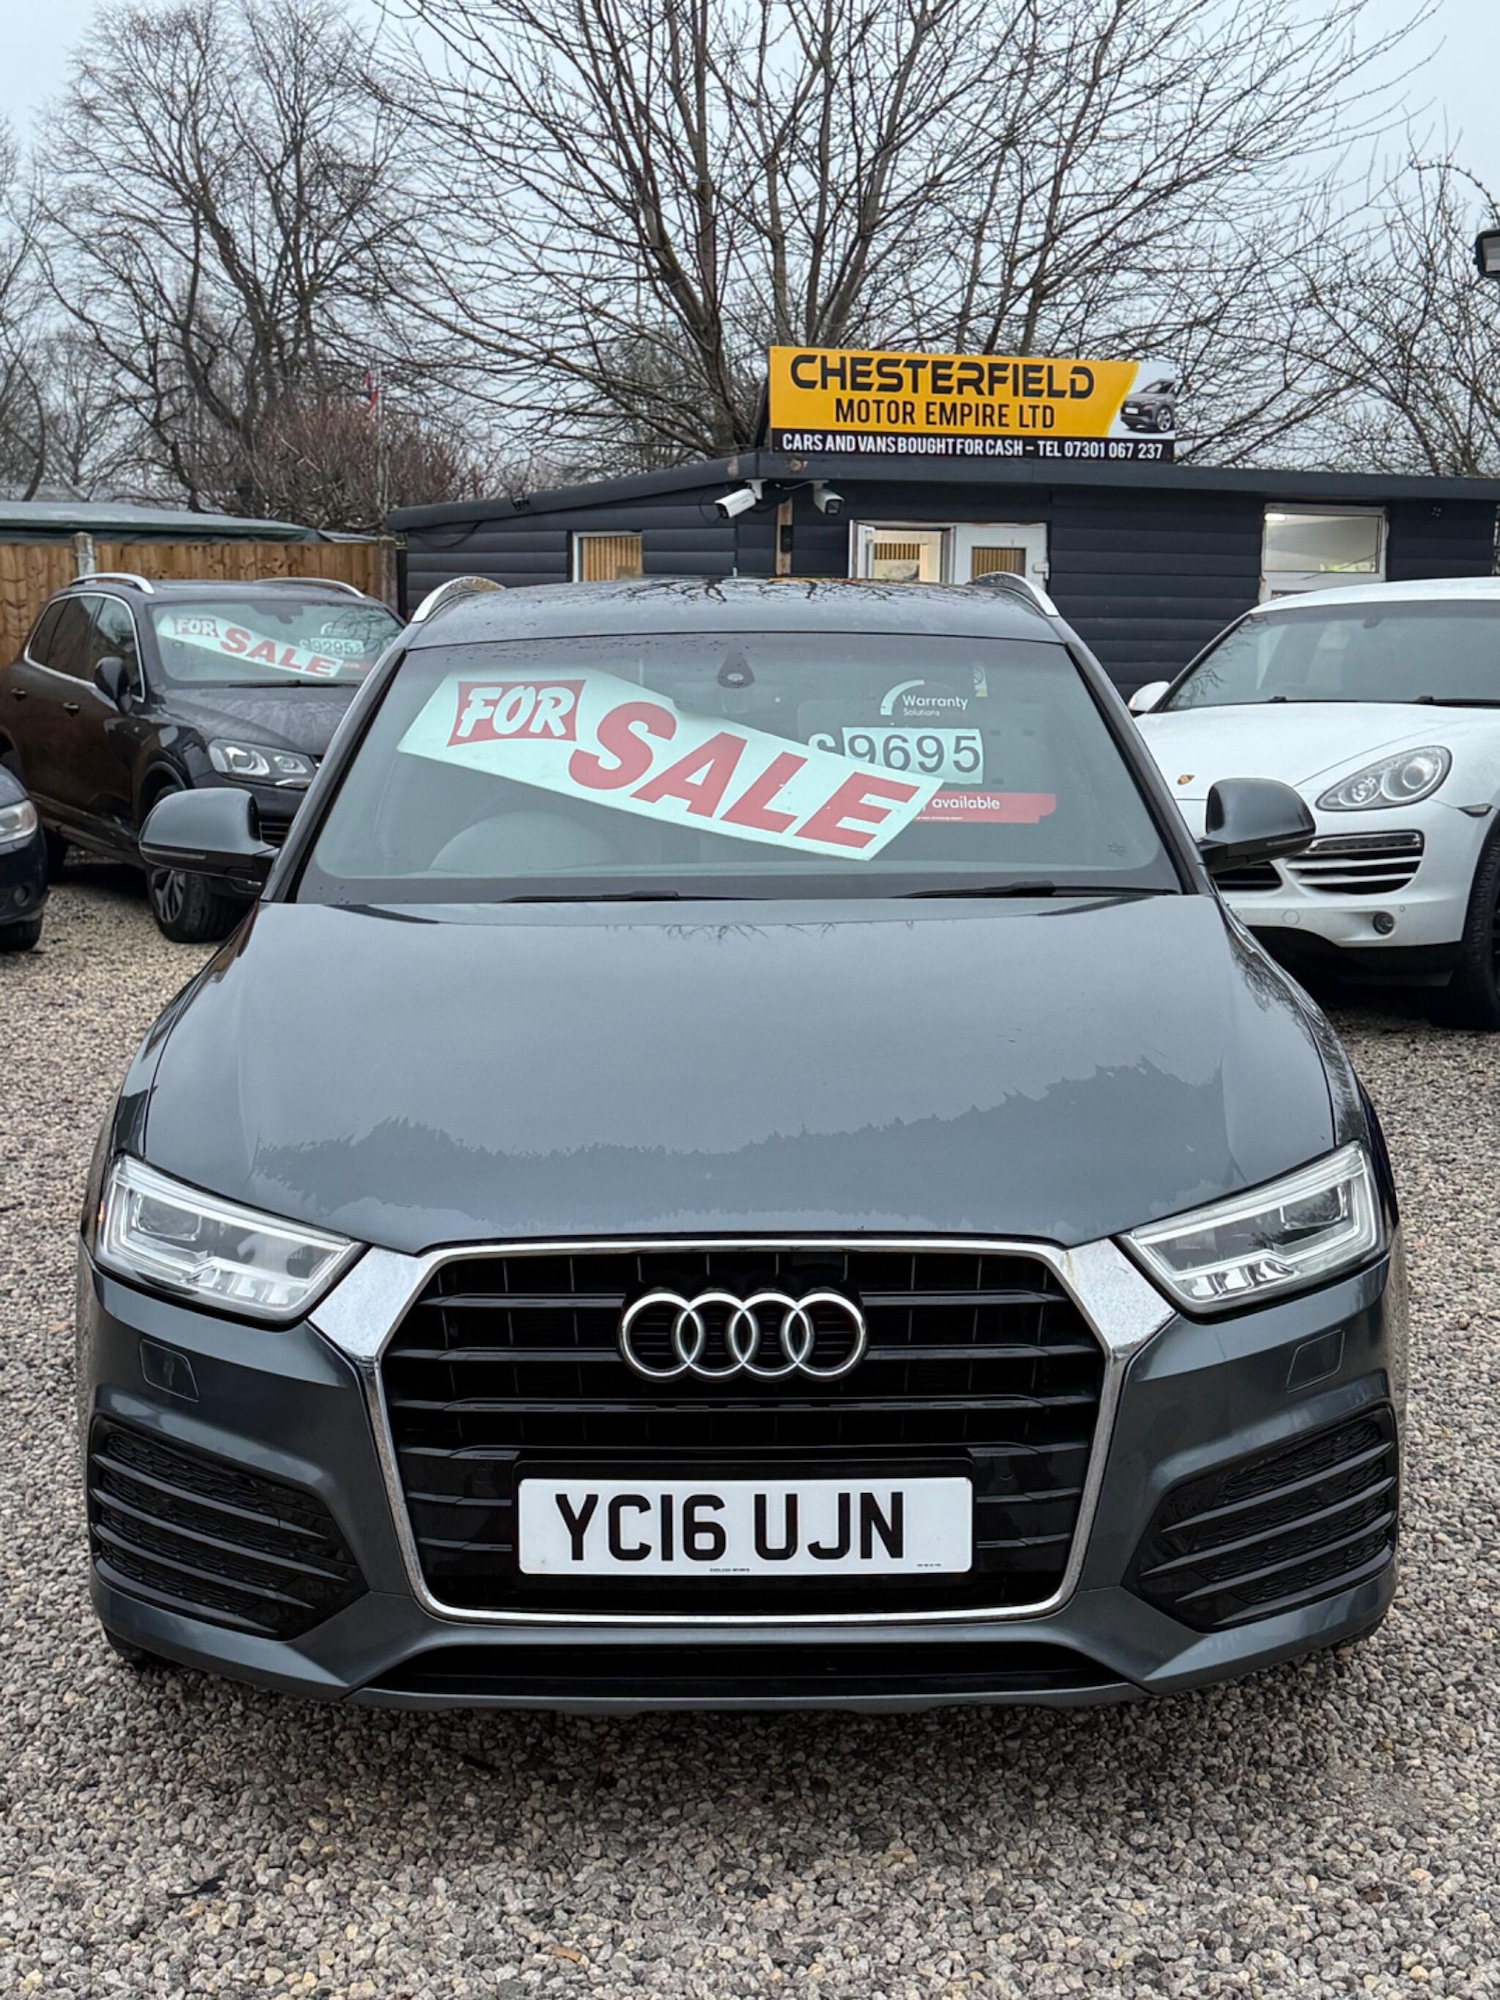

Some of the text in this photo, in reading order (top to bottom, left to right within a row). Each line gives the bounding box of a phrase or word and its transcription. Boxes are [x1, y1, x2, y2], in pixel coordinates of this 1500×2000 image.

[790, 355, 1094, 399] CHESTERFIELD
[835, 398, 1055, 428] MOTOR EMPIRE LTD
[782, 433, 823, 450] CARS
[825, 435, 855, 451] AND
[857, 436, 895, 453] VANS
[897, 438, 954, 454] BOUGHT
[956, 439, 983, 455] FOR
[985, 440, 1023, 456] CASH
[1038, 441, 1061, 457] TEL
[1064, 441, 1105, 457] 07301
[1109, 442, 1133, 458] 067
[1138, 443, 1163, 459] 237
[176, 619, 337, 677] FOR SALE
[902, 694, 968, 711] Warranty
[903, 707, 941, 717] Solutions
[457, 686, 921, 849] FOR SALE
[932, 795, 1000, 809] available
[555, 1491, 904, 1561] YC16 UJN
